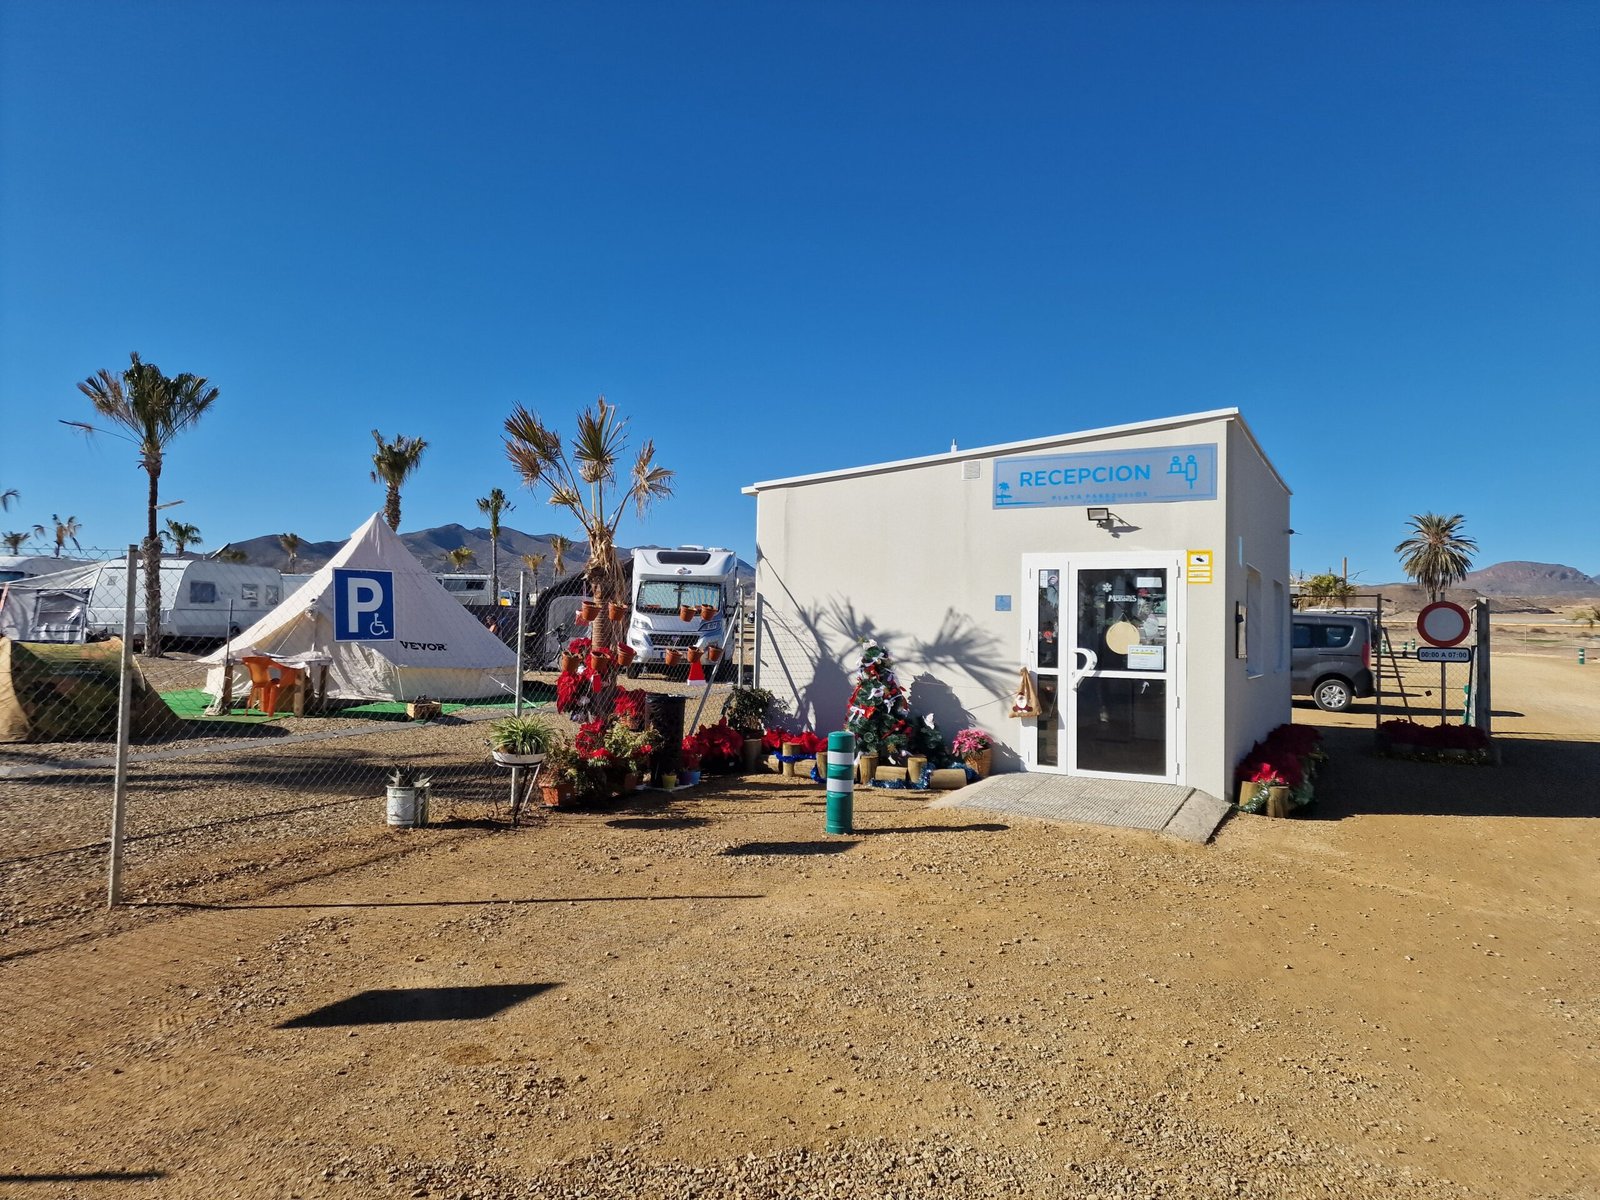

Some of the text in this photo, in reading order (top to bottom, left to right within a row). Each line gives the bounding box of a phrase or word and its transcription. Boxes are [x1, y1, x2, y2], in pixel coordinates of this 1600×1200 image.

[1019, 464, 1151, 487] RECEPCION
[347, 577, 384, 633] P
[400, 640, 447, 651] VEVOR
